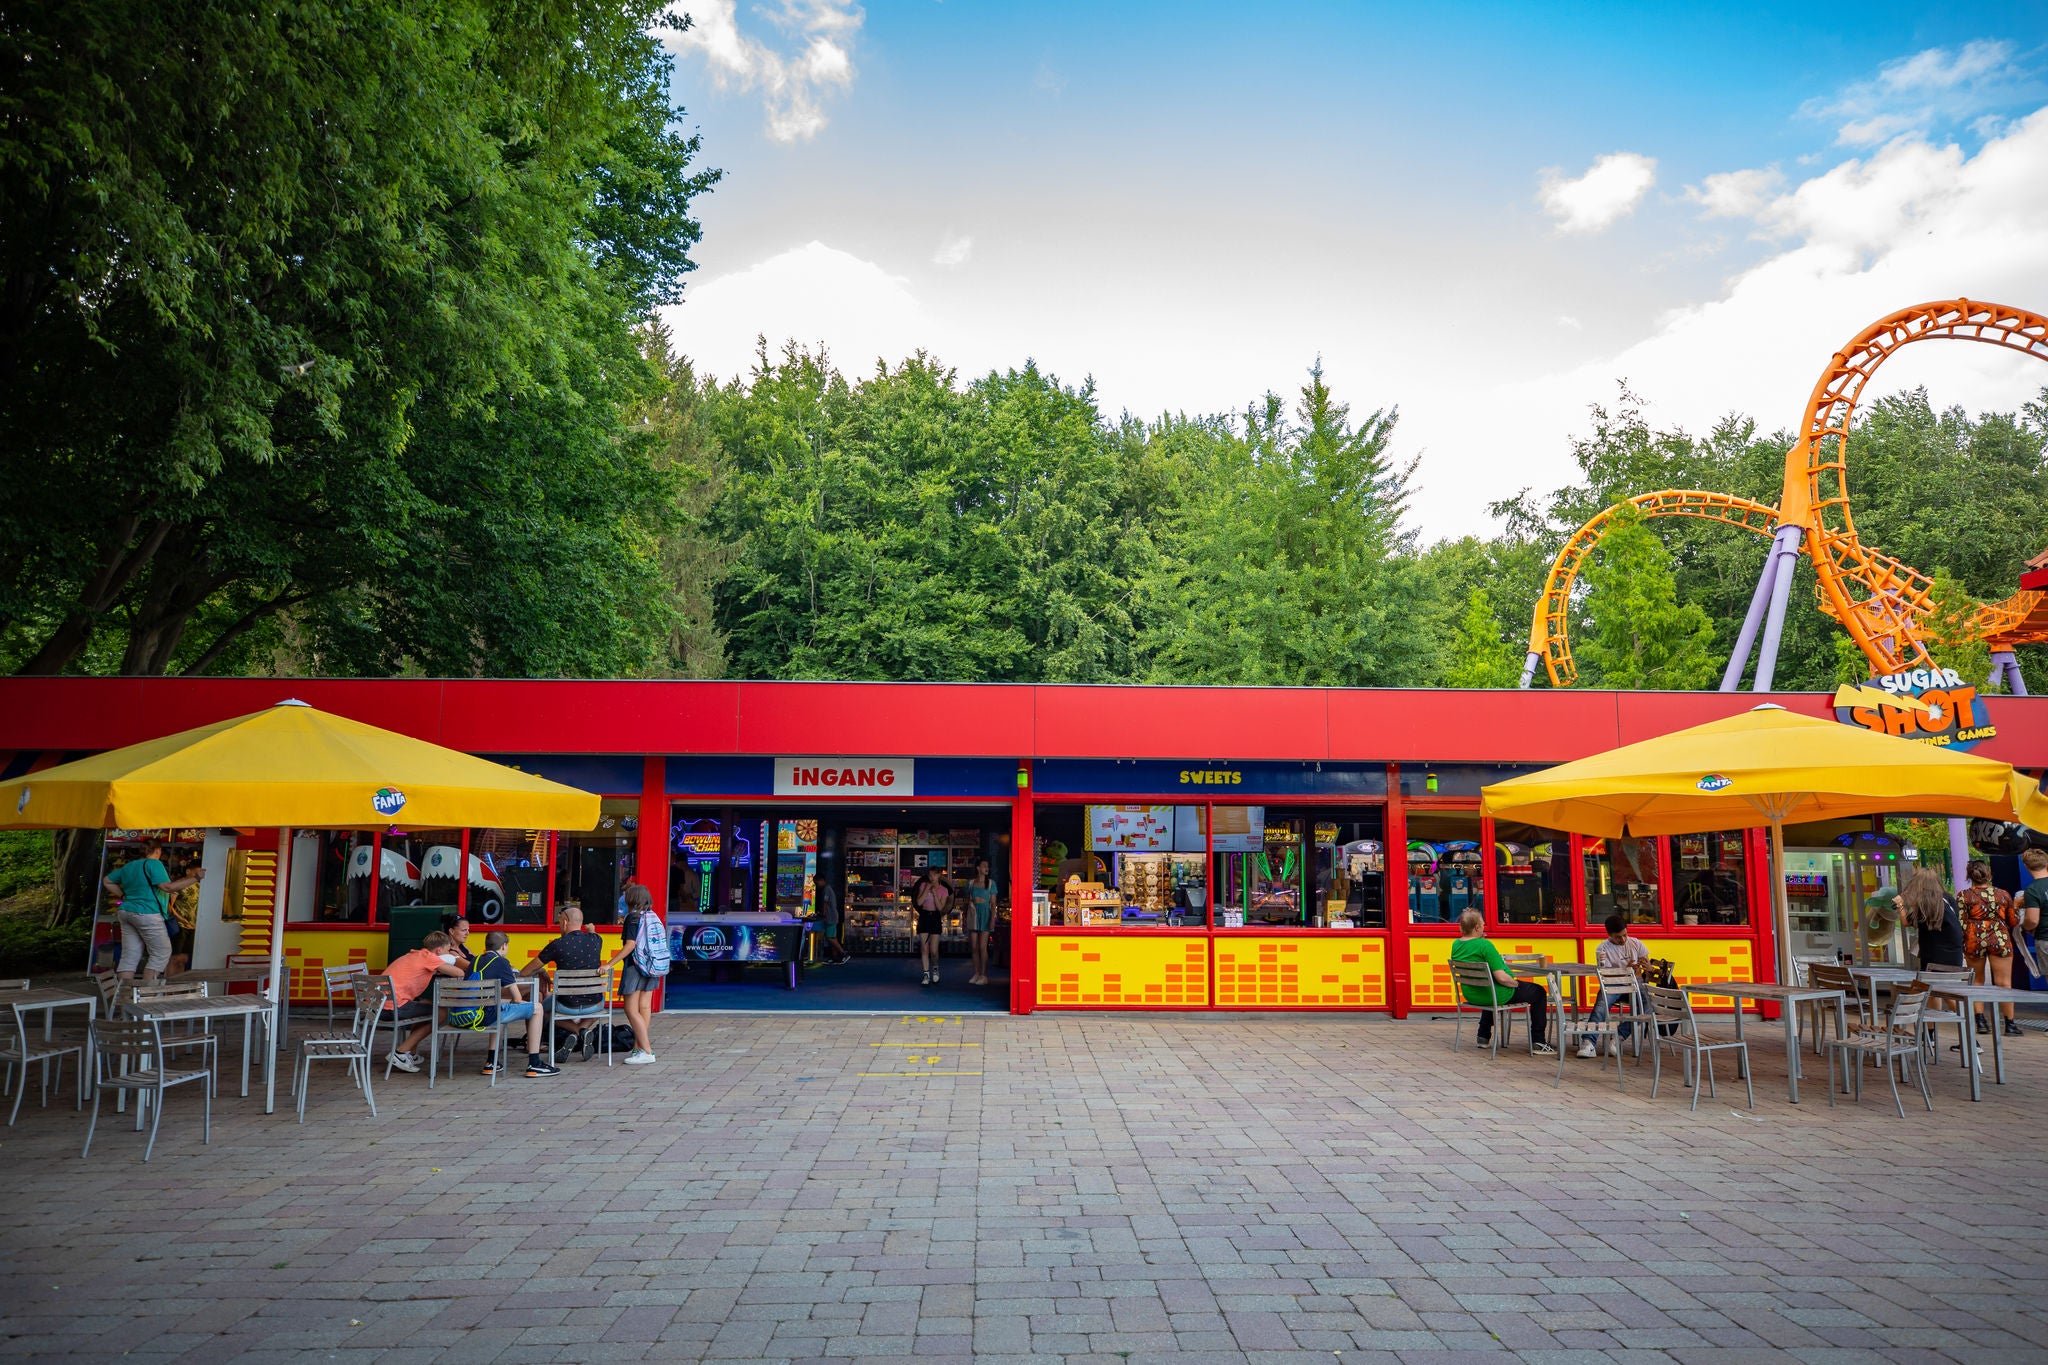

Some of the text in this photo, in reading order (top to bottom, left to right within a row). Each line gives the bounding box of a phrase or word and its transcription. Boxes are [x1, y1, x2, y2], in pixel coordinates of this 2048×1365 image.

[1880, 668, 1966, 694] SUGAR
[1853, 686, 1976, 737] SHOT
[1957, 726, 1997, 741] GAMES
[1180, 770, 1242, 784] SWEETS
[1696, 778, 1733, 789] FANTA
[372, 792, 406, 810] FANTA
[683, 835, 720, 844] BOWLIN
[696, 843, 720, 852] CHAM
